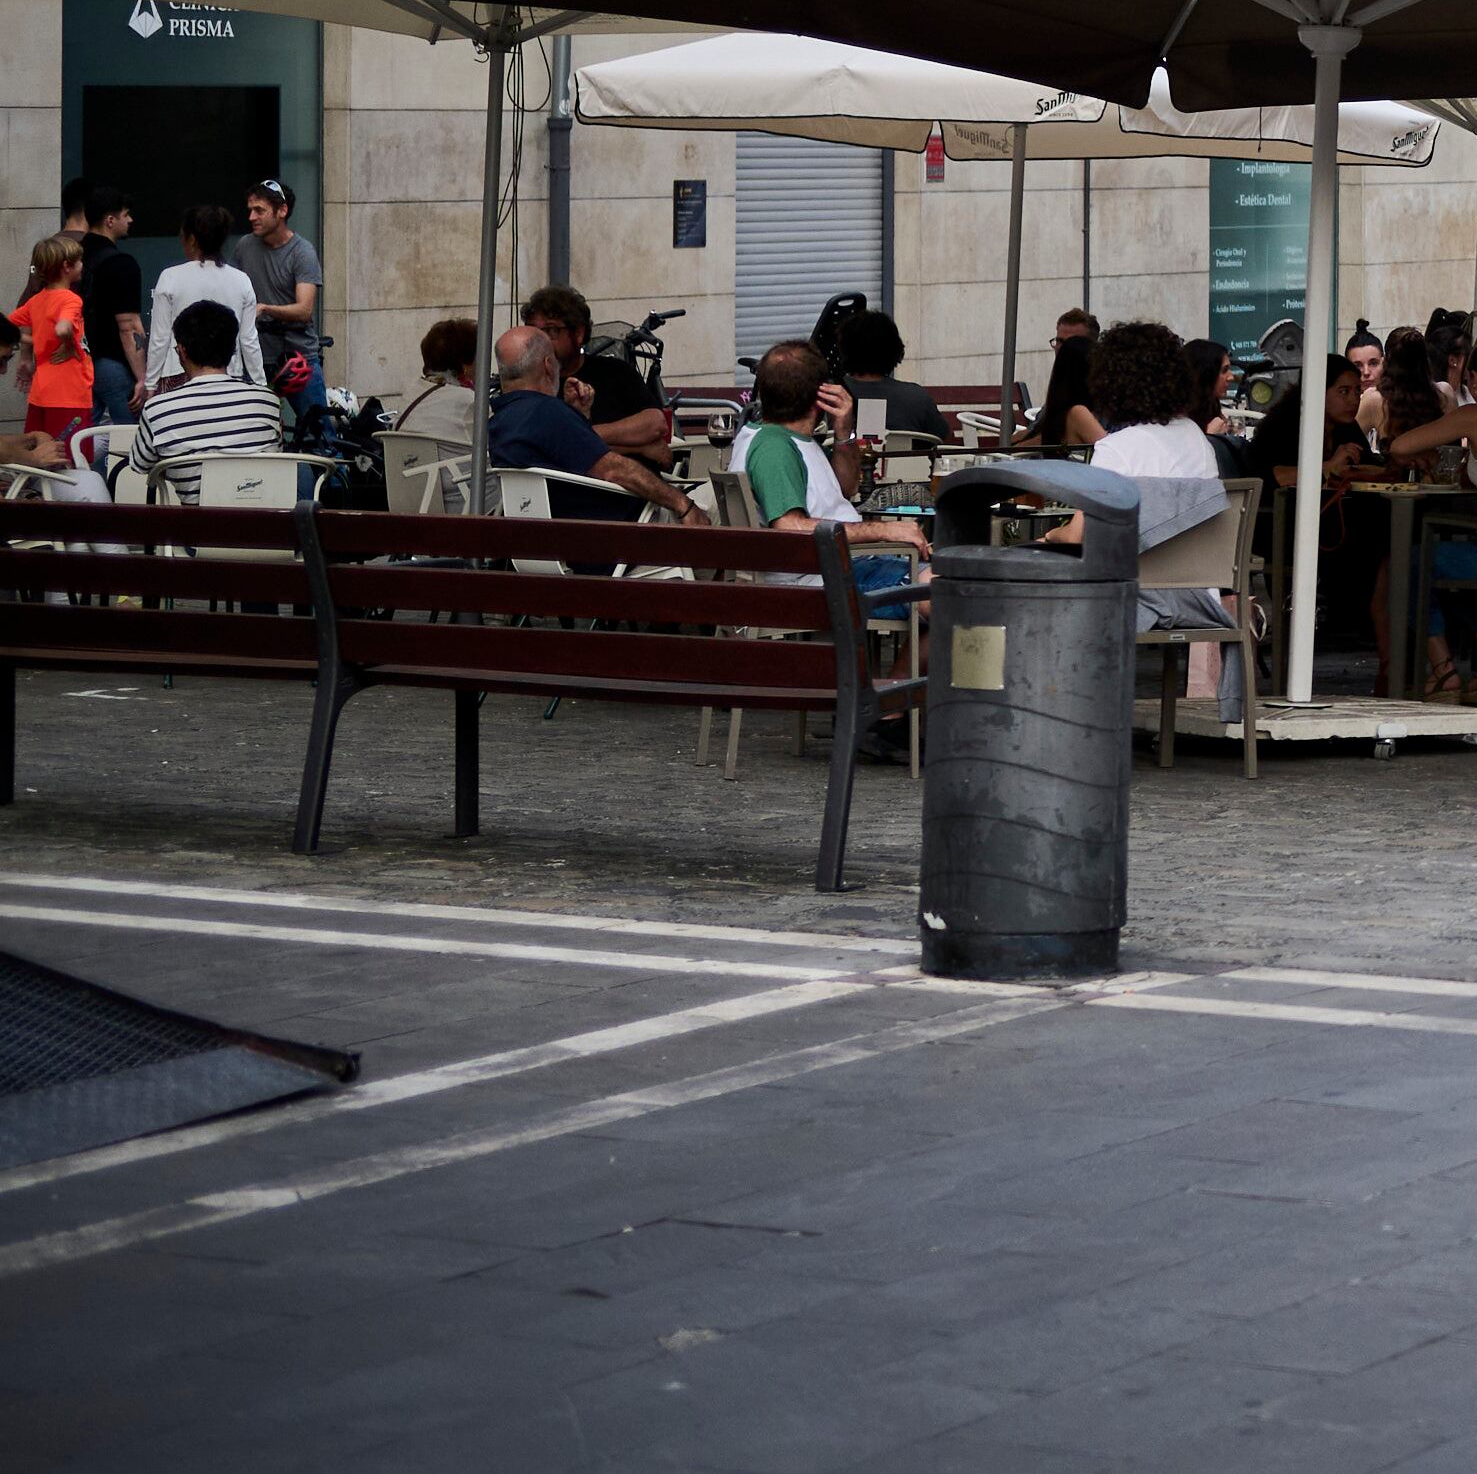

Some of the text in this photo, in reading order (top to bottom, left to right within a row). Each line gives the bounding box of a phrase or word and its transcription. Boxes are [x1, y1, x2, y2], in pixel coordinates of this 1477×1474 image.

[169, 19, 235, 38] PRISMA
[1239, 192, 1291, 206] Estética Dental
